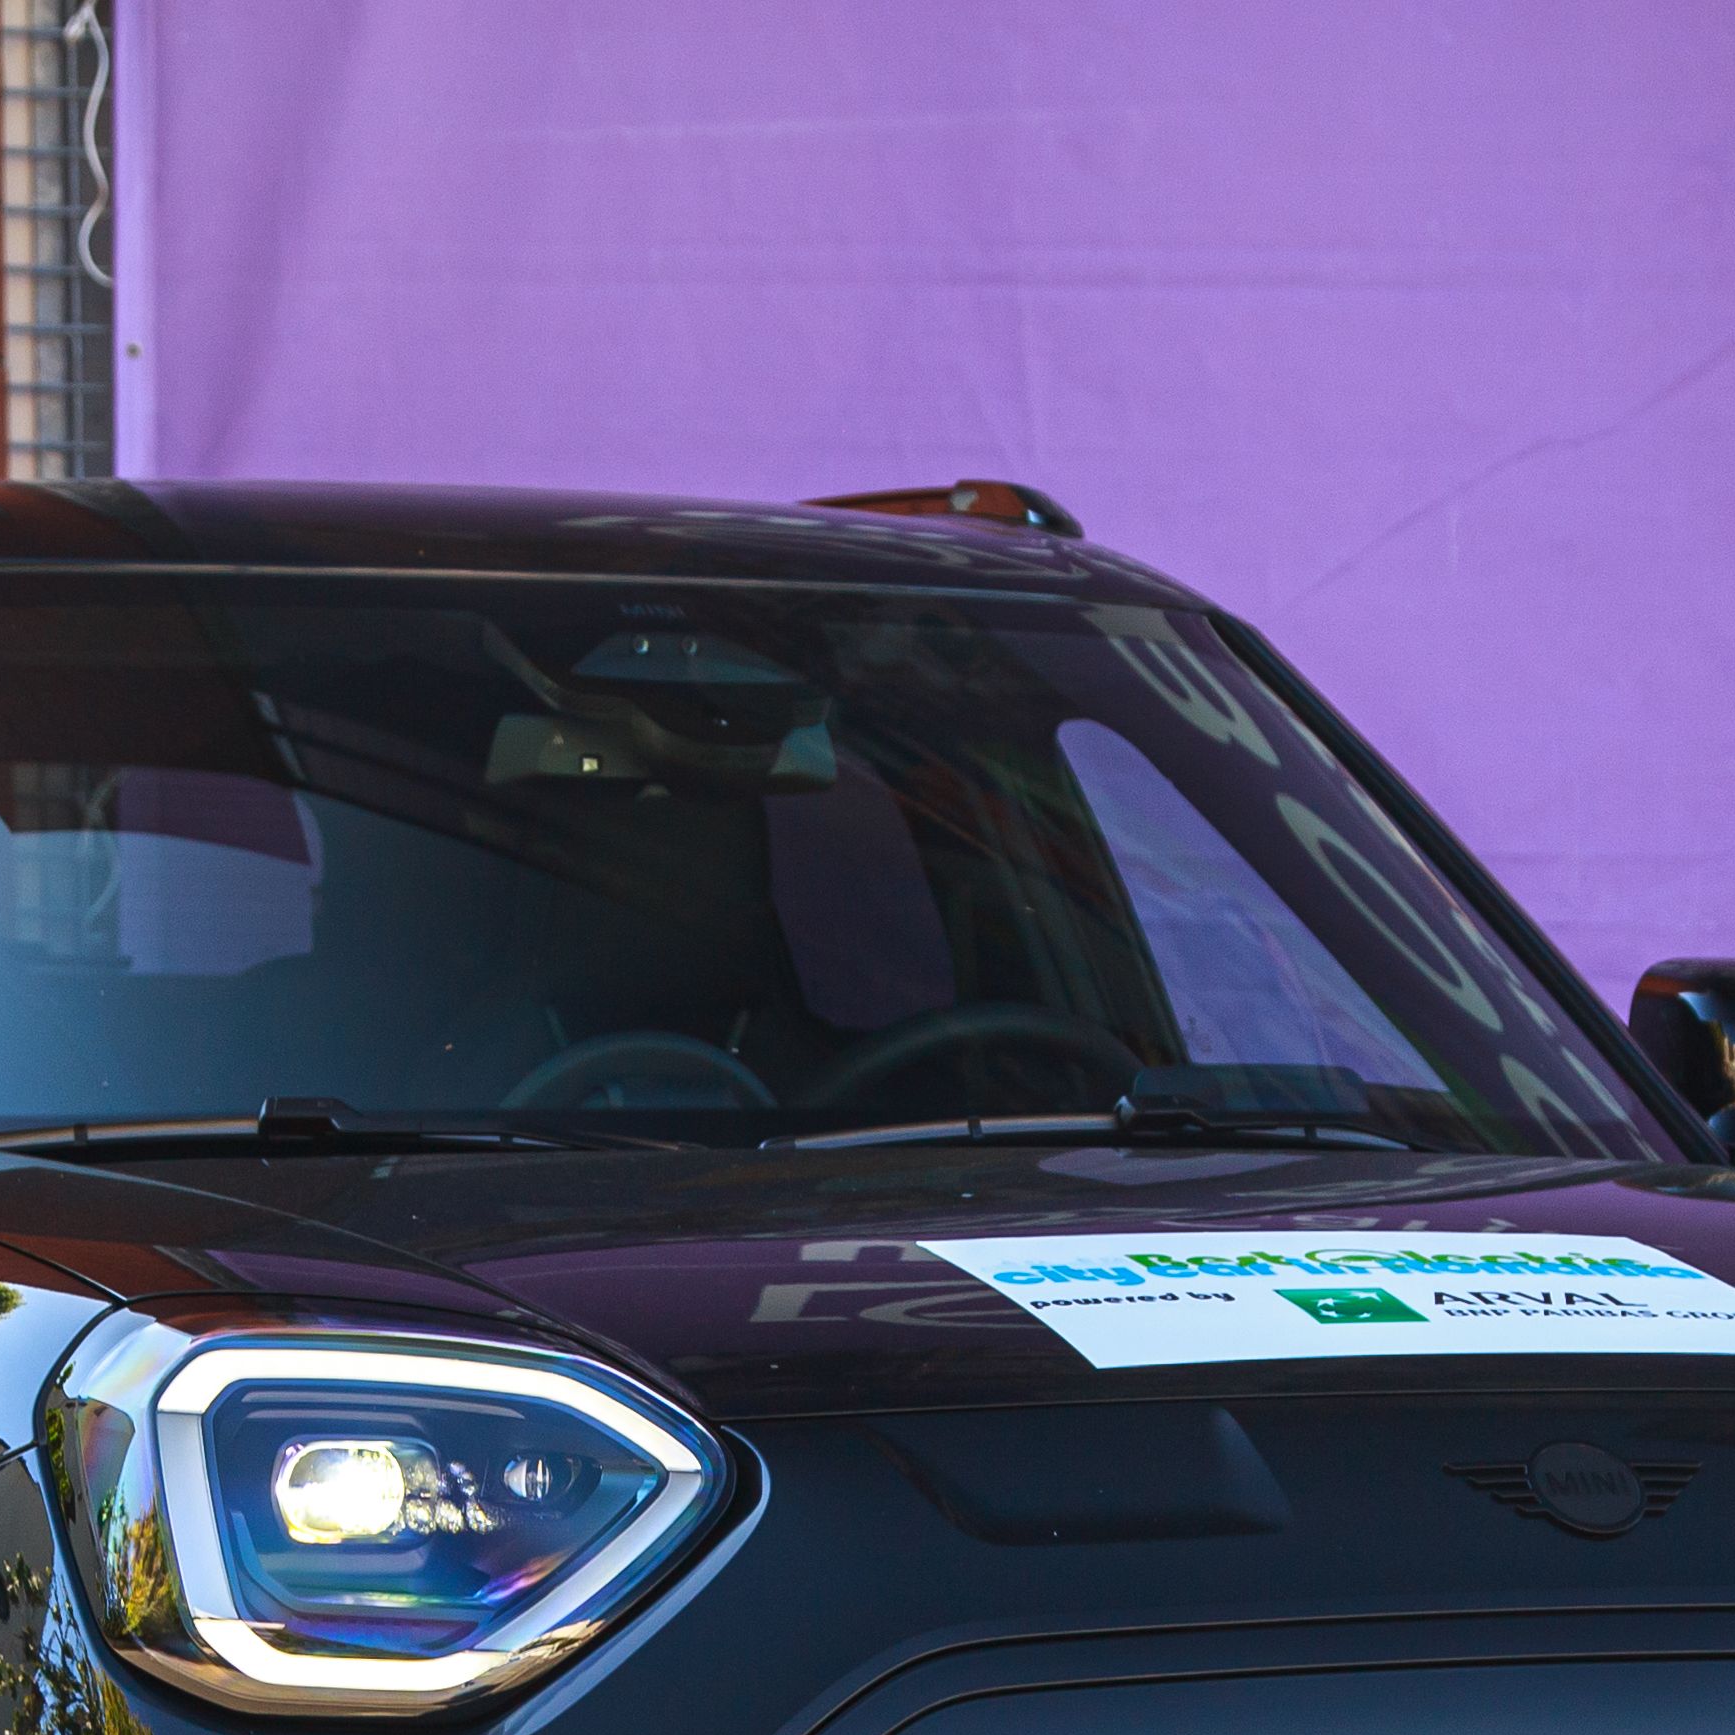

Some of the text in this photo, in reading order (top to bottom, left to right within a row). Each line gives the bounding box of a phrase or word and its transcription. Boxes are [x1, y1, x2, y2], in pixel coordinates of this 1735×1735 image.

[993, 1264, 1146, 1286] city
[1147, 1262, 1278, 1278] car
[1281, 1257, 1373, 1275] in
[1030, 1291, 1236, 1309] powered by
[1433, 1291, 1649, 1308] ARVAL
[1445, 1308, 1511, 1318] BNP
[1520, 1309, 1659, 1319] PARIBAS
